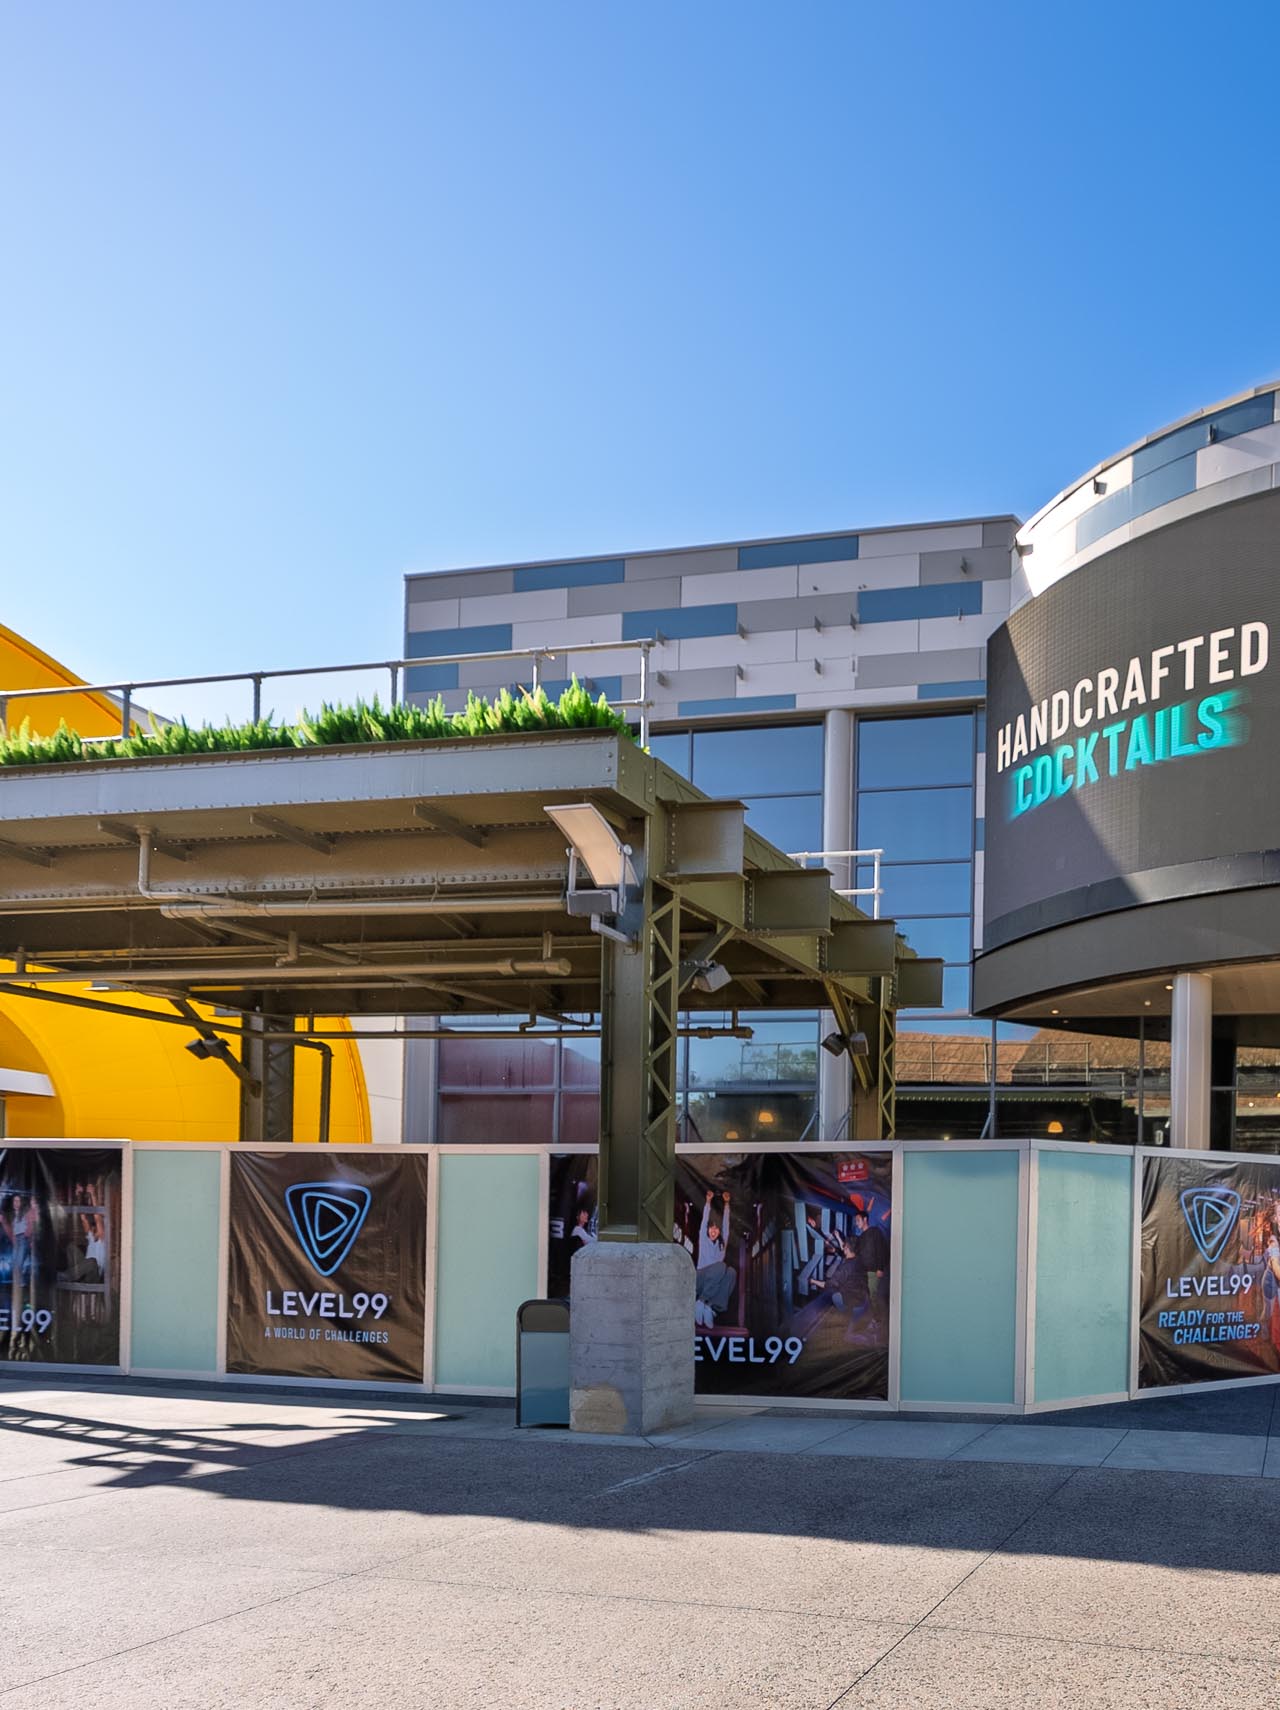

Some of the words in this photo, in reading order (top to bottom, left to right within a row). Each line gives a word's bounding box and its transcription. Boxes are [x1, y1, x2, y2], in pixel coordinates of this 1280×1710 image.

[997, 621, 1269, 774] HANDCRAFTED
[1010, 692, 1238, 818] COCKTAILS
[1166, 1274, 1253, 1298] LEVEL99
[266, 1290, 388, 1320] LEVEL99
[1158, 1310, 1205, 1328] READY
[1206, 1312, 1225, 1325] FOR
[1227, 1311, 1245, 1323] THE
[264, 1327, 271, 1338] A
[273, 1327, 305, 1340] WORLD
[309, 1328, 321, 1341] OF
[324, 1329, 389, 1344] CHALLENGES
[1173, 1322, 1260, 1345] CHALLENGE?
